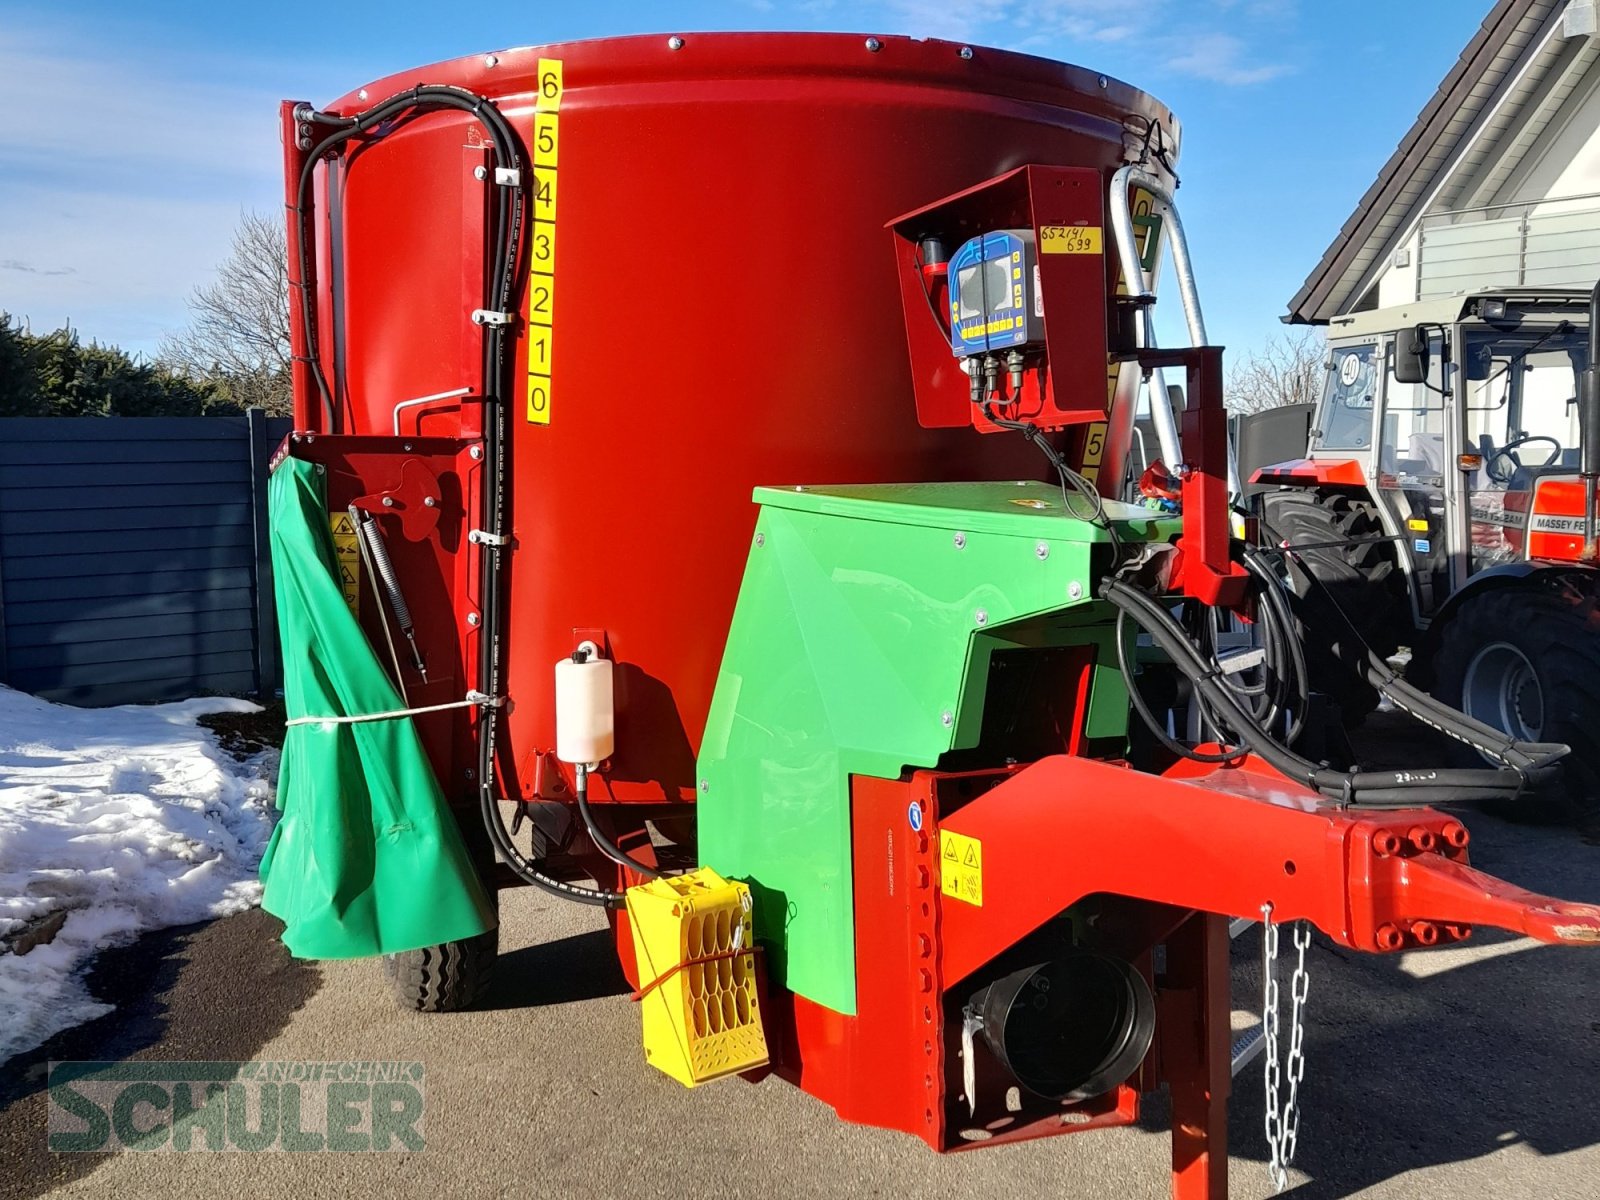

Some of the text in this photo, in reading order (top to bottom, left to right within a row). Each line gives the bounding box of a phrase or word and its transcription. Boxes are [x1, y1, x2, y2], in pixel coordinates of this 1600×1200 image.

[542, 72, 558, 99] 6
[538, 125, 554, 153] 5
[537, 181, 553, 208] 4
[535, 234, 550, 261] 3
[1067, 237, 1092, 252] 699
[533, 286, 549, 313] 2
[535, 338, 545, 363] 1
[1344, 358, 1357, 380] 40
[531, 387, 546, 412] 0
[1088, 433, 1102, 456] 5
[1537, 518, 1585, 531] MASSEY FE
